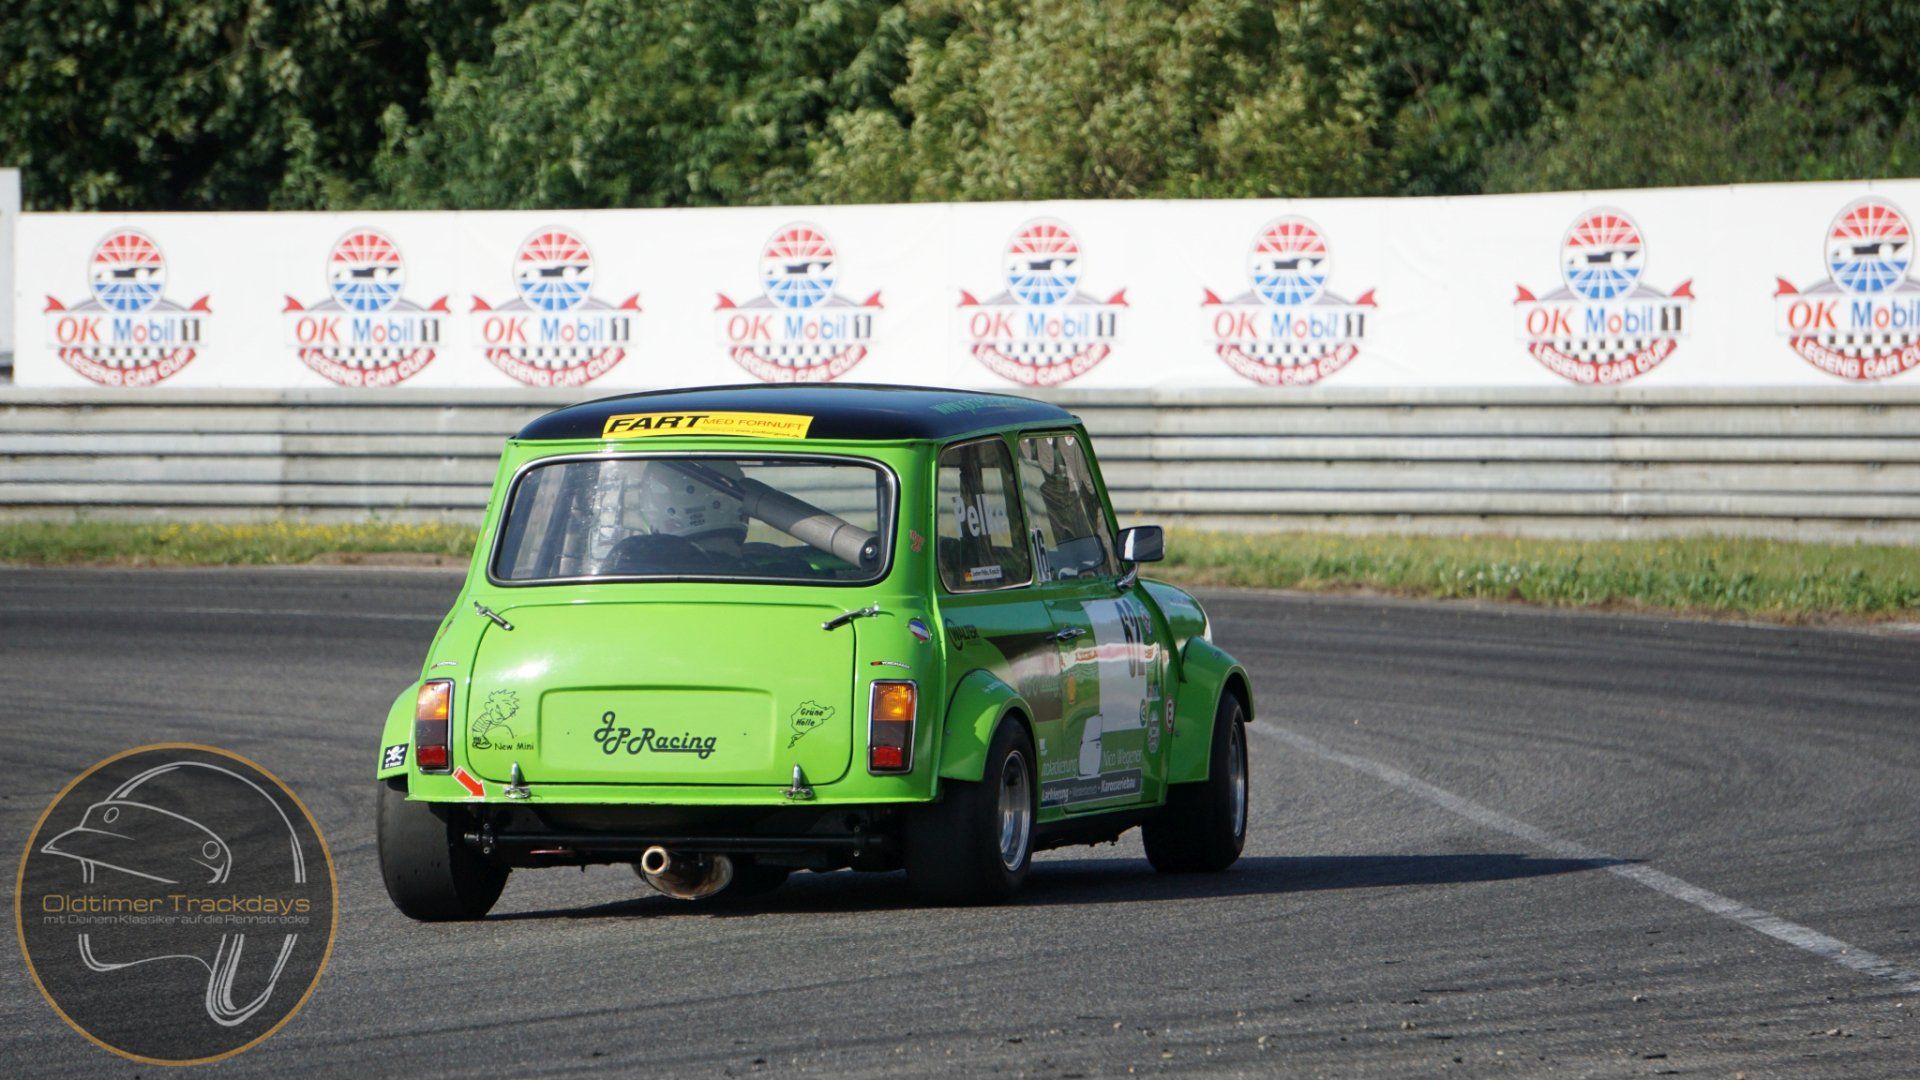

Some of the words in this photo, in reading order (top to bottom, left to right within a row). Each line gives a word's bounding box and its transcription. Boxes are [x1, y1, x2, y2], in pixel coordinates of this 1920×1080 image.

[728, 314, 771, 341] OK
[785, 315, 847, 340] Mobil
[970, 312, 1014, 338] OK
[1027, 313, 1089, 338] Mobil
[1214, 311, 1257, 338] OK
[1271, 312, 1338, 338] Mobil
[1527, 308, 1571, 336] OK
[1586, 307, 1653, 333] Mobil
[1788, 300, 1838, 329] OK
[57, 317, 101, 344] OK
[113, 318, 175, 342] Mobil
[296, 317, 340, 343] OK
[353, 318, 414, 343] Mobil
[483, 317, 527, 343] OK
[540, 318, 603, 342] Mobil
[1534, 343, 1595, 383] LEGEND
[1598, 360, 1635, 383] CAR
[607, 415, 709, 433] FART
[738, 419, 804, 430] FORNUFT
[494, 742, 513, 750] New
[516, 742, 534, 750] Mini
